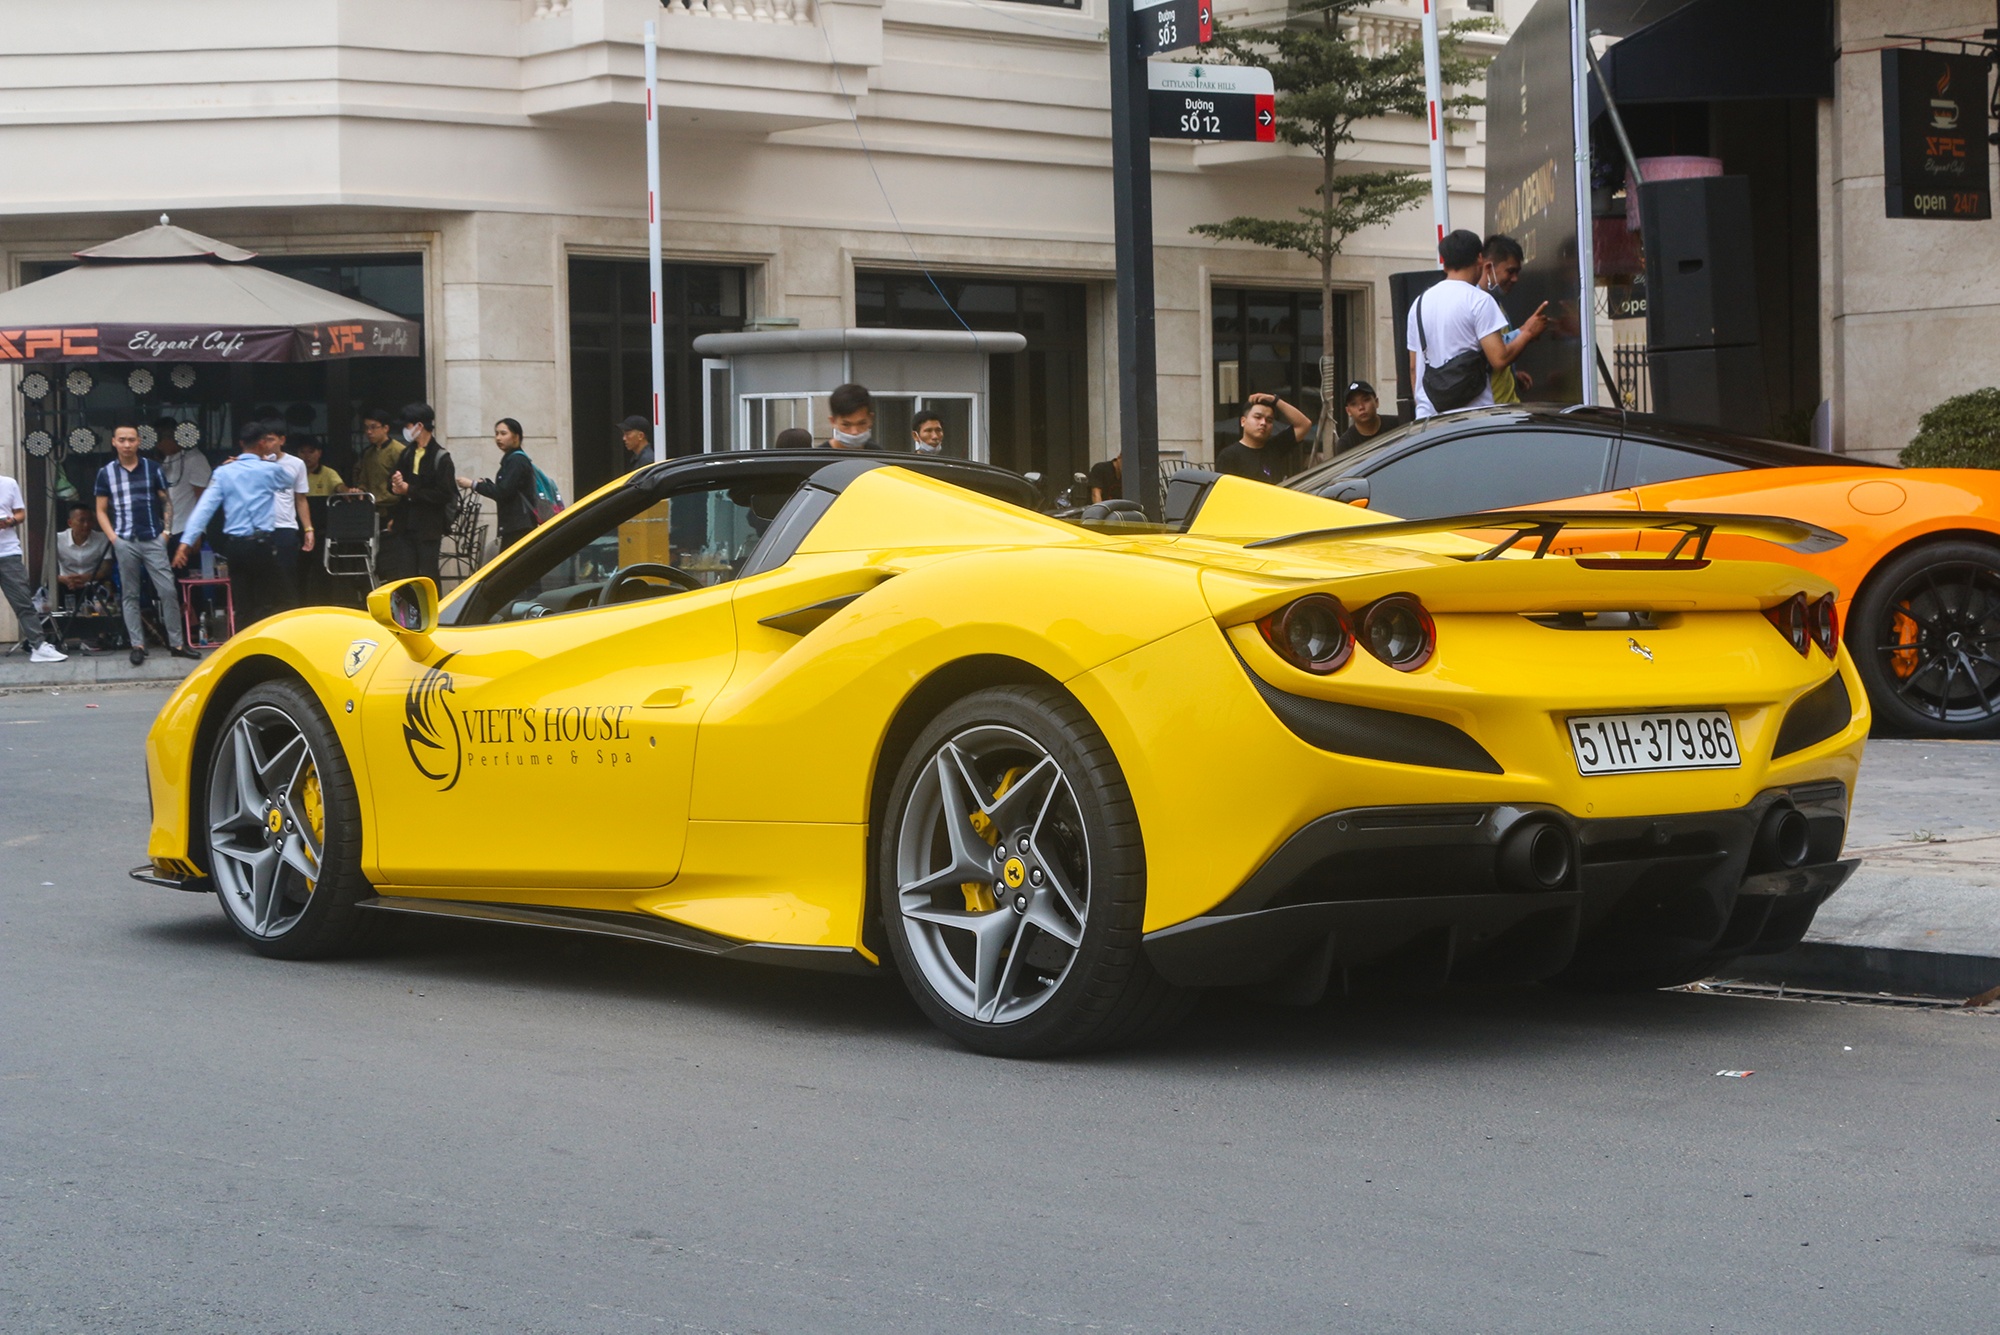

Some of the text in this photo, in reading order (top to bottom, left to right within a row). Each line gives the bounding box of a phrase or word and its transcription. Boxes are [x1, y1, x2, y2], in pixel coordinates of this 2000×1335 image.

[1170, 25, 1177, 44] 3
[1161, 80, 1236, 90] CITYLAND PARK HILLS
[1185, 98, 1214, 113] Đường
[1202, 116, 1221, 133] 12
[1521, 158, 1555, 222] OPENING
[1914, 194, 1978, 214] open 24/7
[1622, 299, 1647, 314] ope
[129, 331, 199, 357] Elegant
[202, 330, 245, 357] Café
[461, 705, 633, 744] VIET'S HOUSE
[1574, 717, 1733, 766] 51H-379.86
[467, 749, 633, 768] Perfume & Spa
